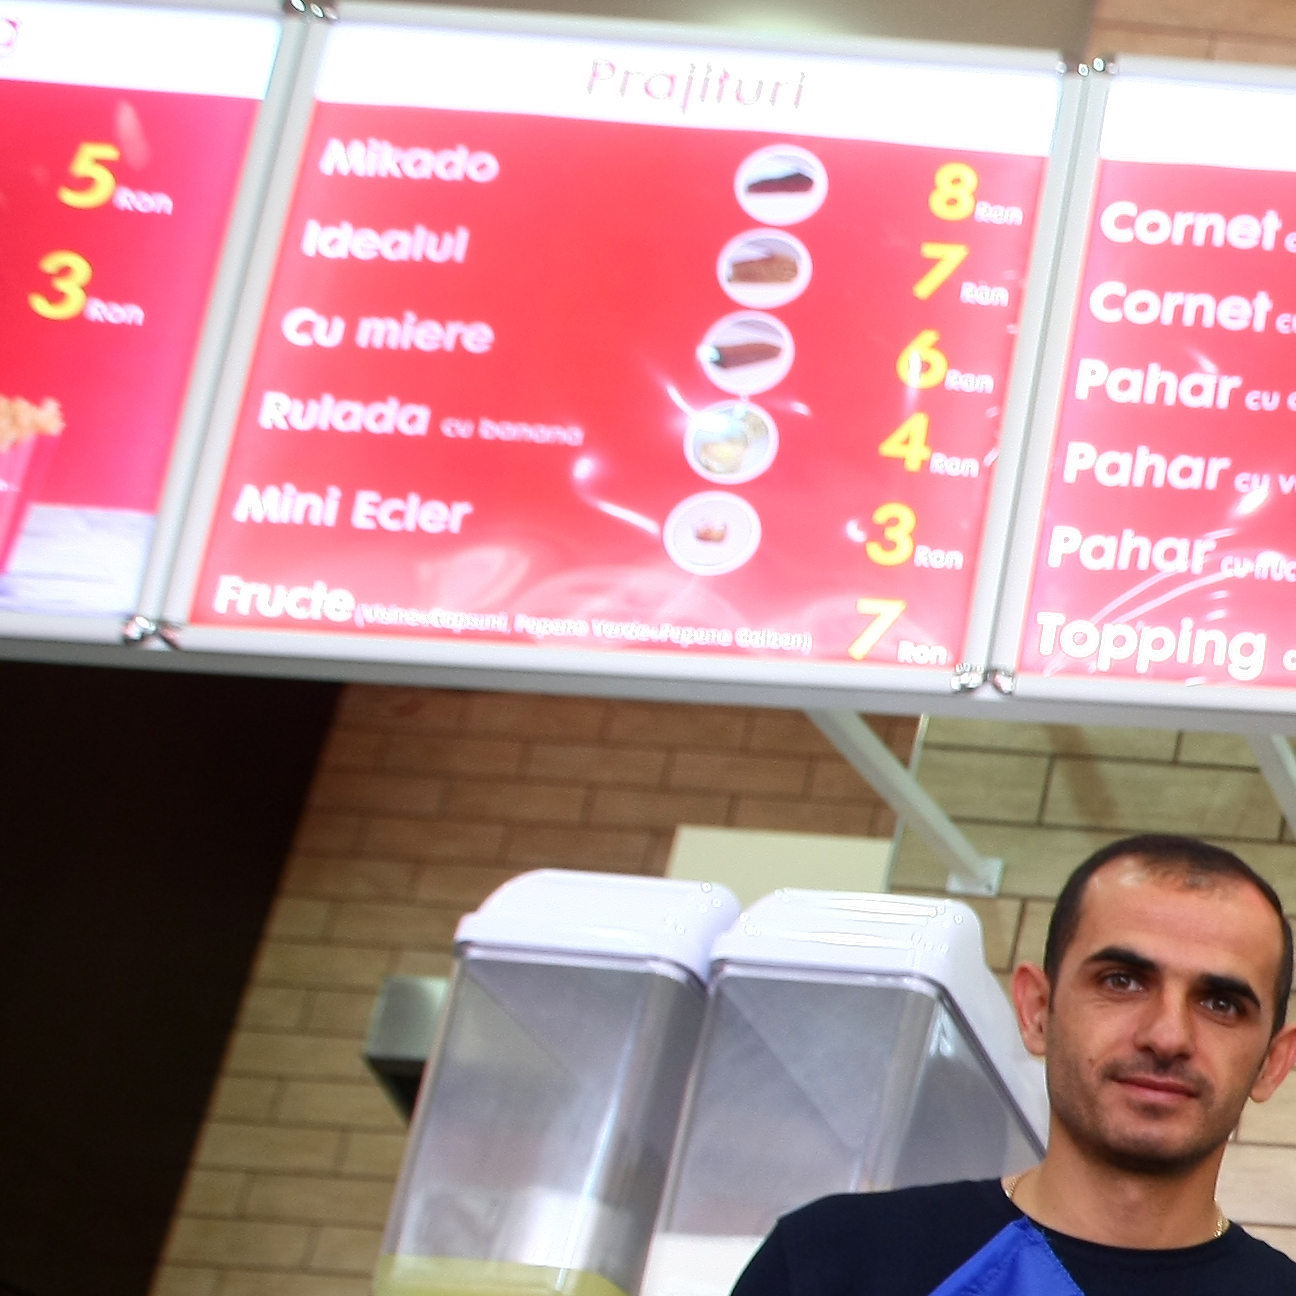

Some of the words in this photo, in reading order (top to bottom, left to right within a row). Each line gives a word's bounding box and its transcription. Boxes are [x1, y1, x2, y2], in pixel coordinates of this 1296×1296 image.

[586, 57, 806, 114] Prajituri
[57, 143, 119, 209] 5
[113, 186, 173, 215] Ron
[319, 138, 499, 183] Mikado
[929, 162, 978, 221] 8
[975, 201, 1023, 226] Ron
[301, 220, 469, 264] Idealul
[1101, 201, 1281, 251] Cornet
[28, 250, 92, 320] 3
[84, 295, 144, 326] Ron
[913, 243, 969, 300] 7
[960, 282, 1009, 307] Ron
[282, 308, 343, 348] Cu
[356, 308, 494, 353] miere
[1089, 280, 1272, 332] Cornet
[896, 330, 947, 390] 6
[945, 369, 993, 394] Ron
[1075, 358, 1242, 410] Pahar
[1245, 388, 1280, 411] cu
[259, 391, 430, 436] Rulada
[440, 418, 471, 439] cu
[878, 413, 931, 472] 4
[930, 453, 979, 478] Ron
[1063, 442, 1231, 491] Pahar
[1234, 471, 1270, 494] cu
[233, 484, 338, 526] Mini
[350, 490, 471, 535] Ecler
[864, 502, 914, 565] 3
[914, 546, 963, 570] Ron
[1047, 525, 1216, 574] Pahar
[848, 598, 907, 660] 7
[898, 640, 947, 665] Ron
[1036, 611, 1267, 681] Topping
